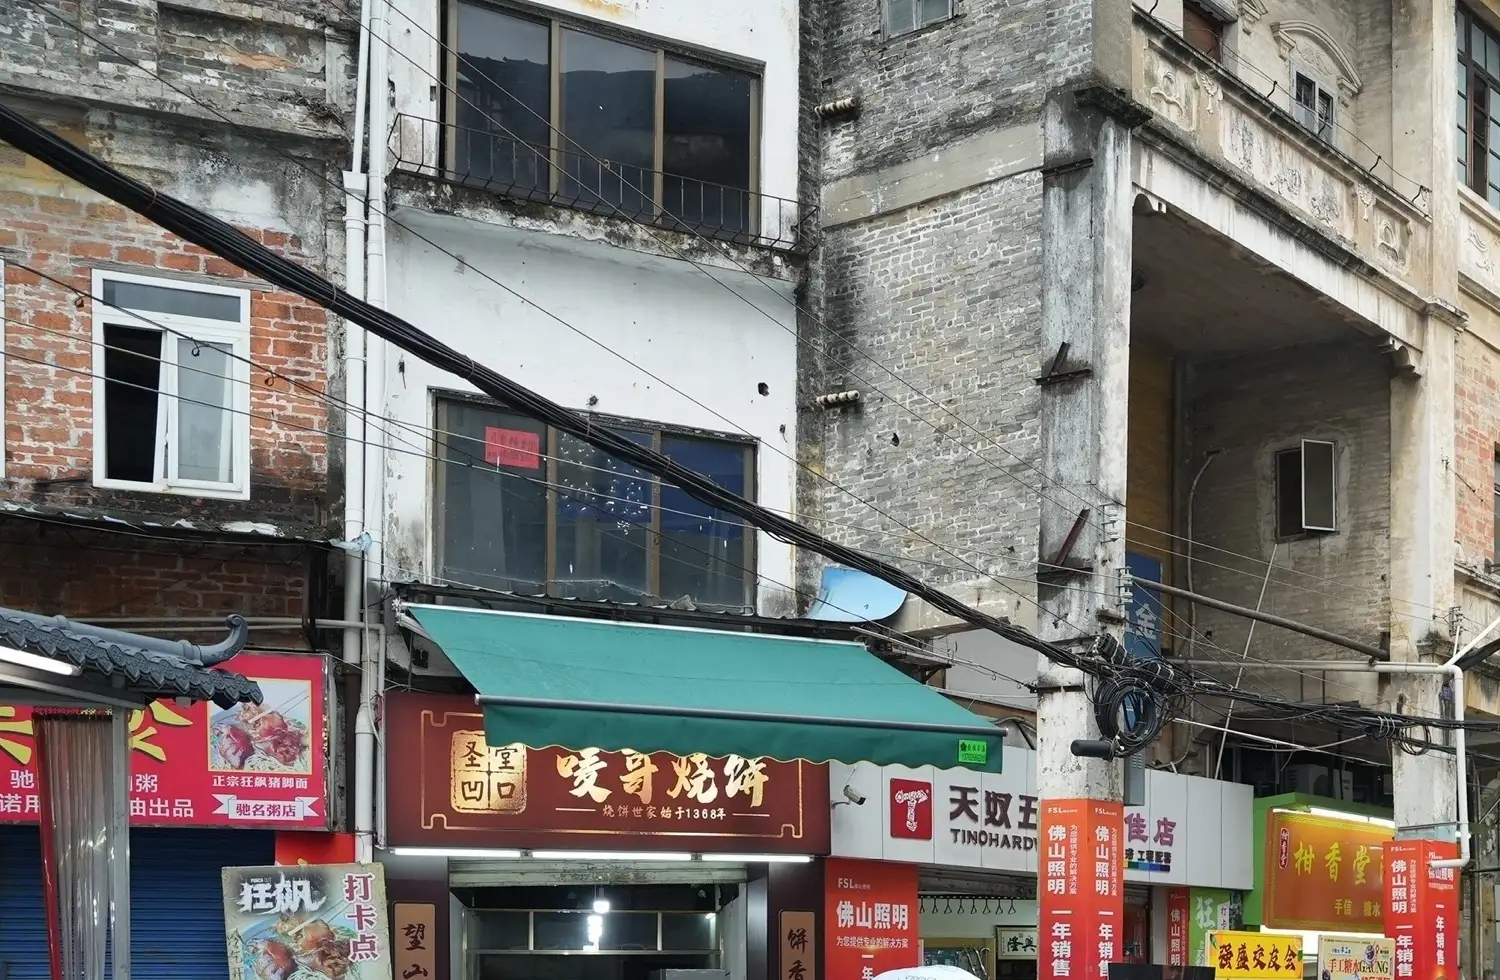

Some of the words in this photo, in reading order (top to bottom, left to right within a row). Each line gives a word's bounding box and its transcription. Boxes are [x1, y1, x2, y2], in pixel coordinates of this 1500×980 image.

[235, 801, 297, 819] 驰名粥店
[602, 803, 727, 822] 烧饼世家始于1368年
[1047, 807, 1063, 815] FSL
[1095, 807, 1107, 815] FSL
[1047, 825, 1067, 895] 佛山照明
[1095, 825, 1110, 896] 佛山照明
[1293, 841, 1384, 886] 柑香堂
[837, 877, 854, 889] FSL
[1391, 860, 1407, 914] 佛山照明
[344, 873, 379, 961] 打卡点
[836, 900, 909, 930] 佛山照明
[836, 936, 909, 950] 为您提供专业的解决方案
[1051, 909, 1073, 978] 一年销售
[1218, 942, 1297, 972] 强盛交友会
[1395, 924, 1414, 977] 一年销售
